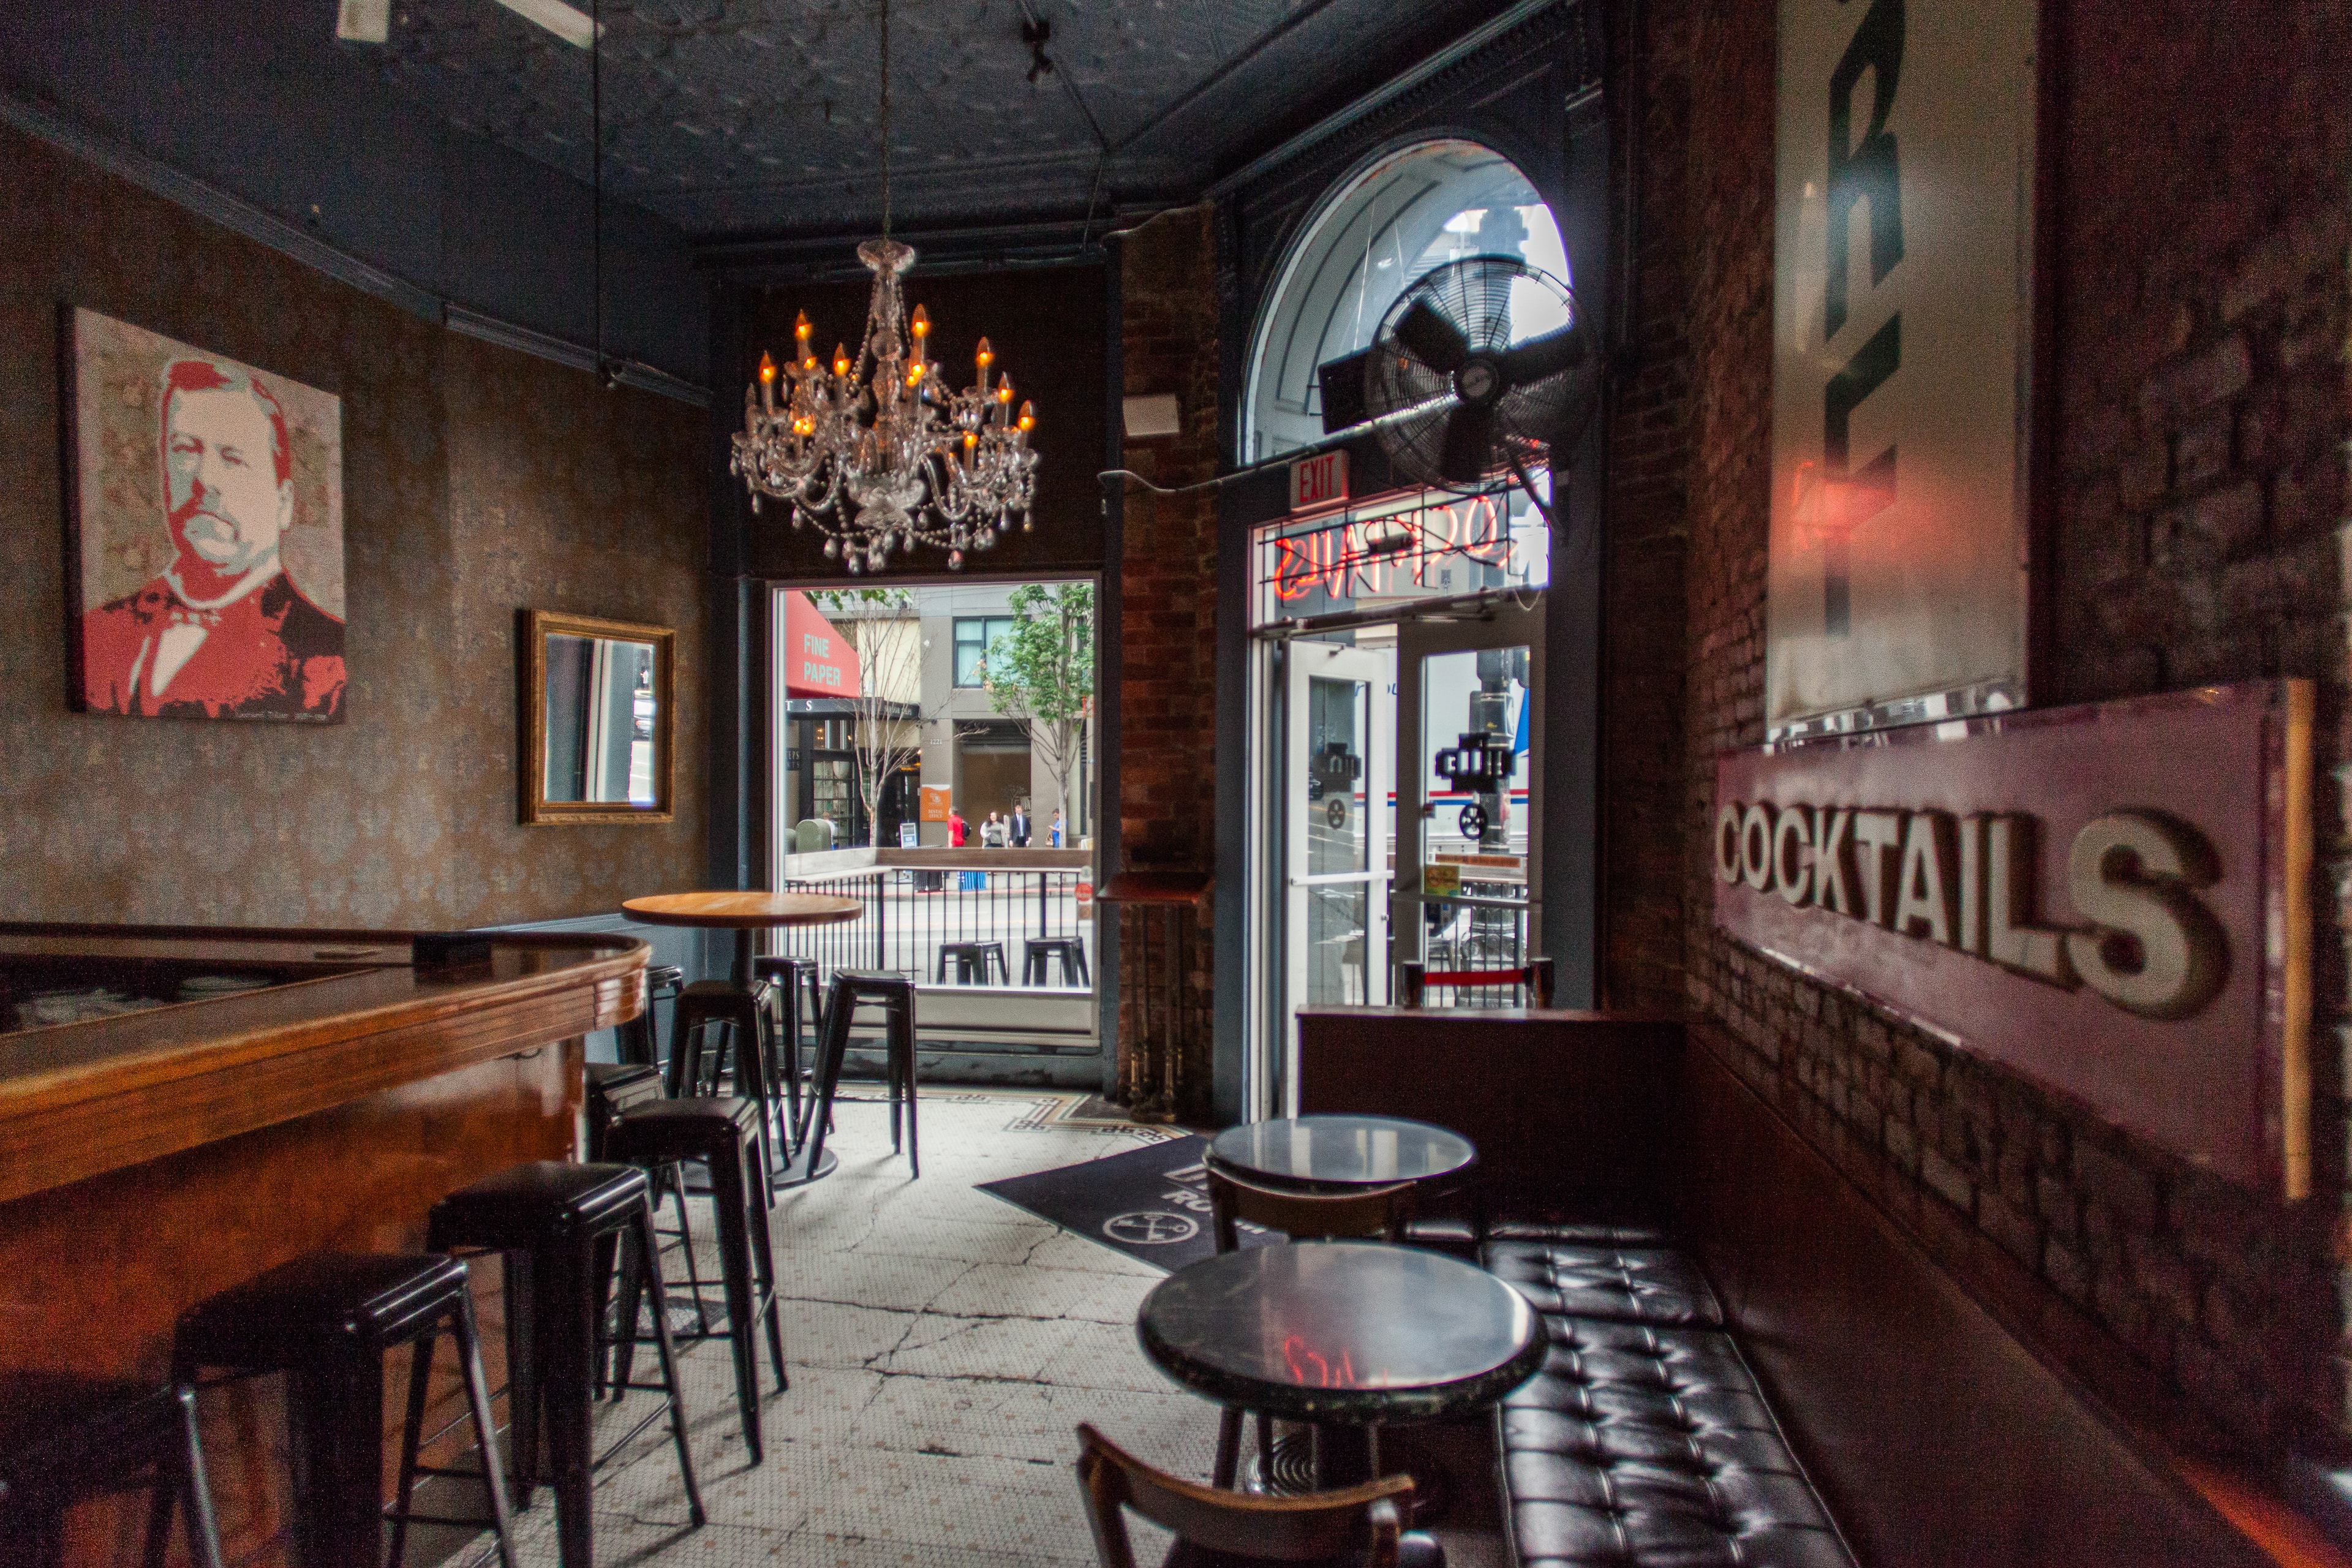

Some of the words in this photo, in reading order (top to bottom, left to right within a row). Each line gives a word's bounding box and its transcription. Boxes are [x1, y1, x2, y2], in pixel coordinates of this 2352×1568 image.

[1298, 455, 1335, 503] EXIT
[804, 633, 829, 657] FINE
[804, 661, 840, 685] PAPER
[1716, 799, 2228, 1019] COCKTAILS
